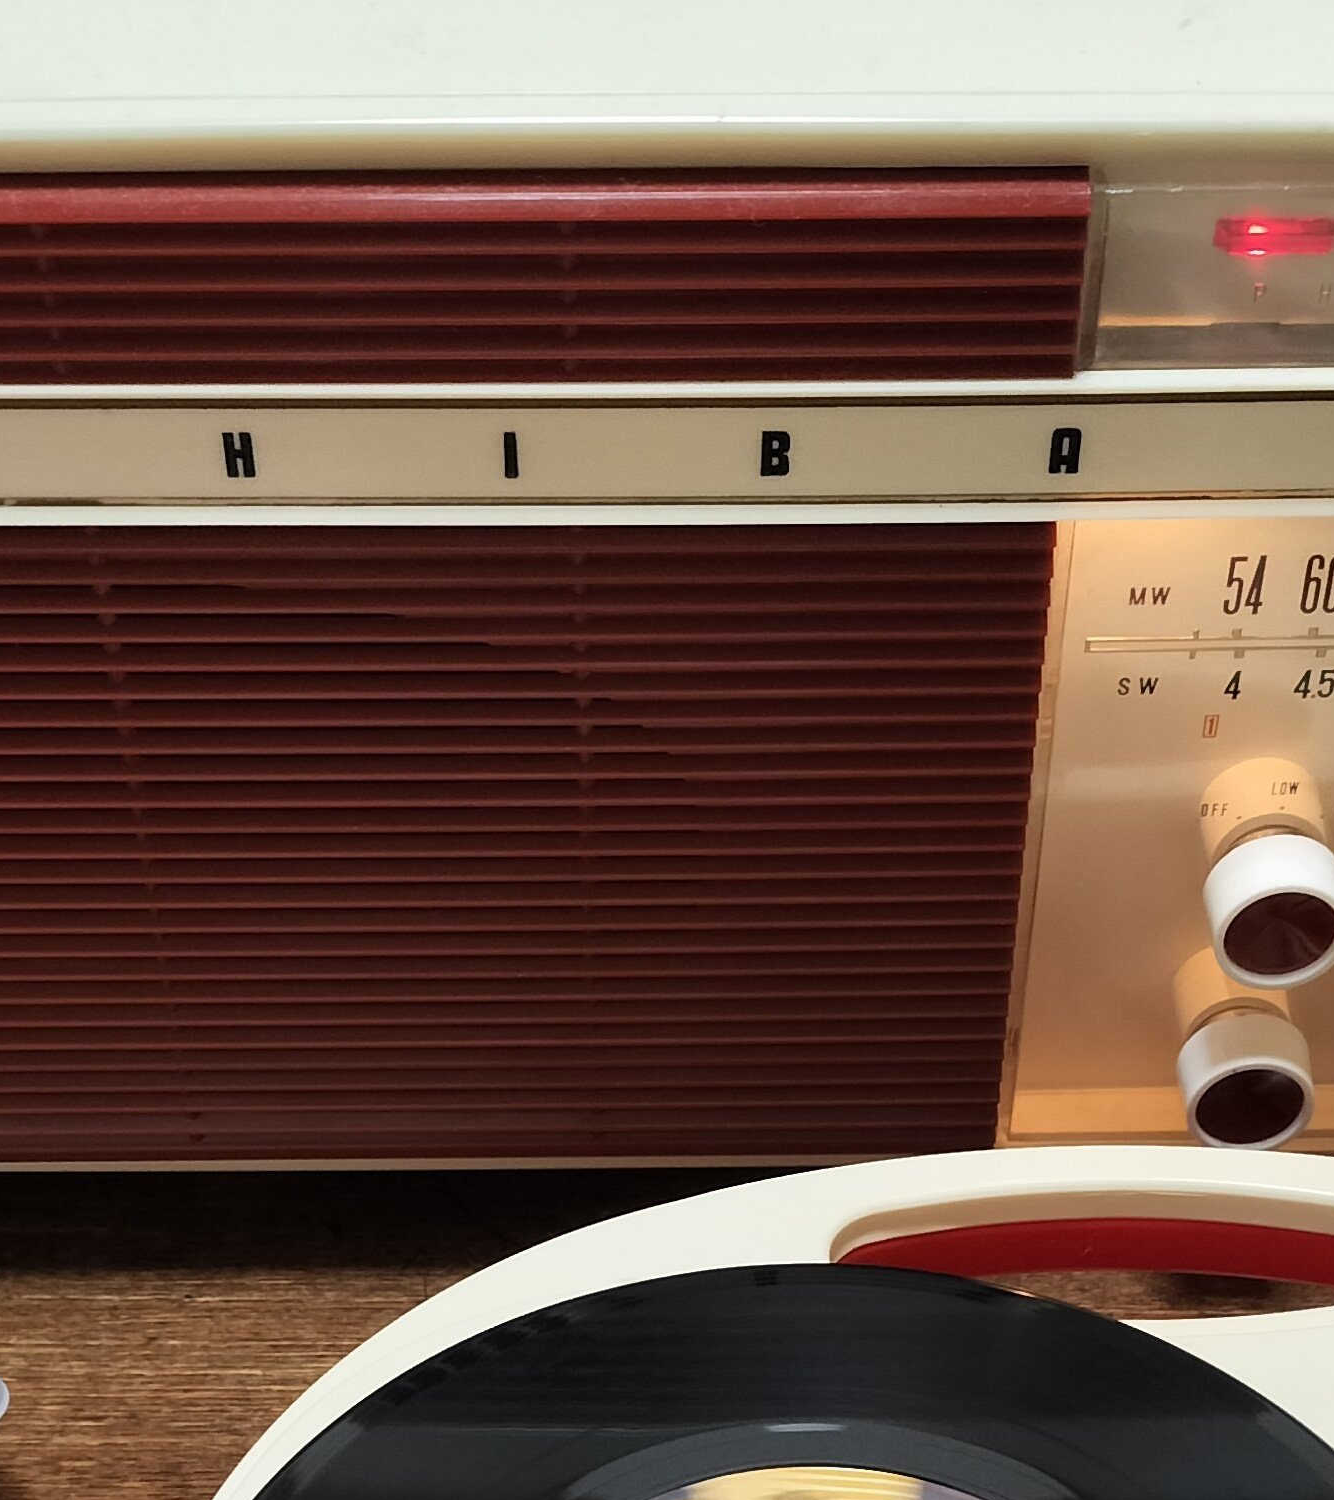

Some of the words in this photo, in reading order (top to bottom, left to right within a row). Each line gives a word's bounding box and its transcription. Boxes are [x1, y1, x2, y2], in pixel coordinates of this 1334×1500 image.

[1129, 586, 1170, 606] MW
[1223, 555, 1267, 615] 54
[1117, 677, 1159, 696] SW
[1224, 670, 1242, 700] 4
[1271, 780, 1299, 796] LOW
[1200, 802, 1229, 818] OFF
